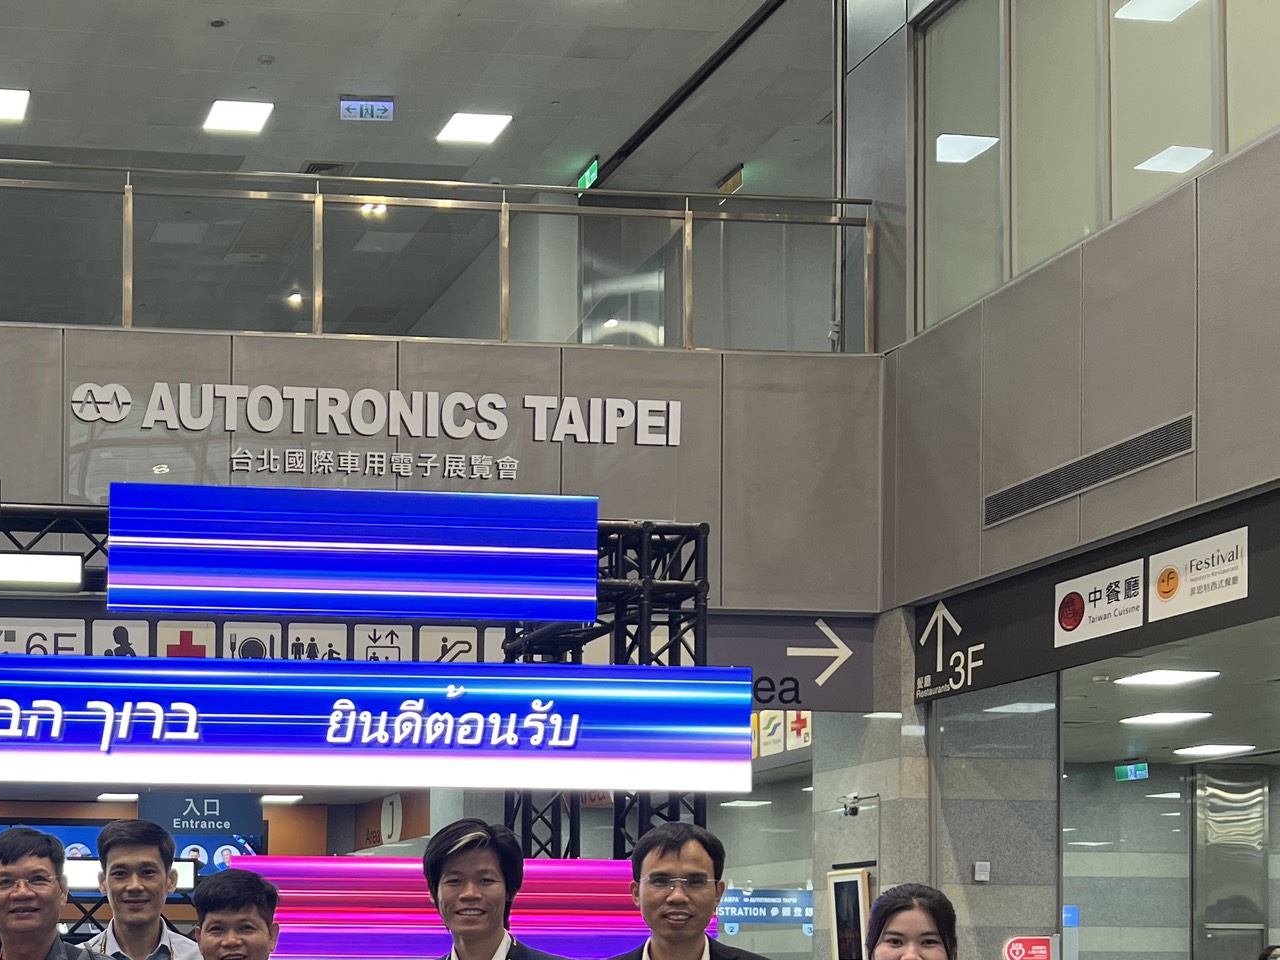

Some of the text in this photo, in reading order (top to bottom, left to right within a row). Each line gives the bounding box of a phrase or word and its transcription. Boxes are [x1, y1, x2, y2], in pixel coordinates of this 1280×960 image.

[141, 382, 682, 447] AUTOTRONICS TAIPEI
[229, 447, 521, 481] 台北國際車用電子展覽會
[1189, 545, 1239, 573] Festival
[1088, 576, 1140, 608] 中餐廳
[1088, 605, 1140, 624] Taiwan Cuisine
[948, 643, 985, 690] 3F
[753, 676, 802, 704] ea
[86, 700, 200, 752] ברוך
[326, 684, 580, 747] ยินดีต้อนรับ
[182, 798, 220, 816] 入口
[173, 818, 231, 829] Entrance
[716, 906, 767, 917] ISTRATION
